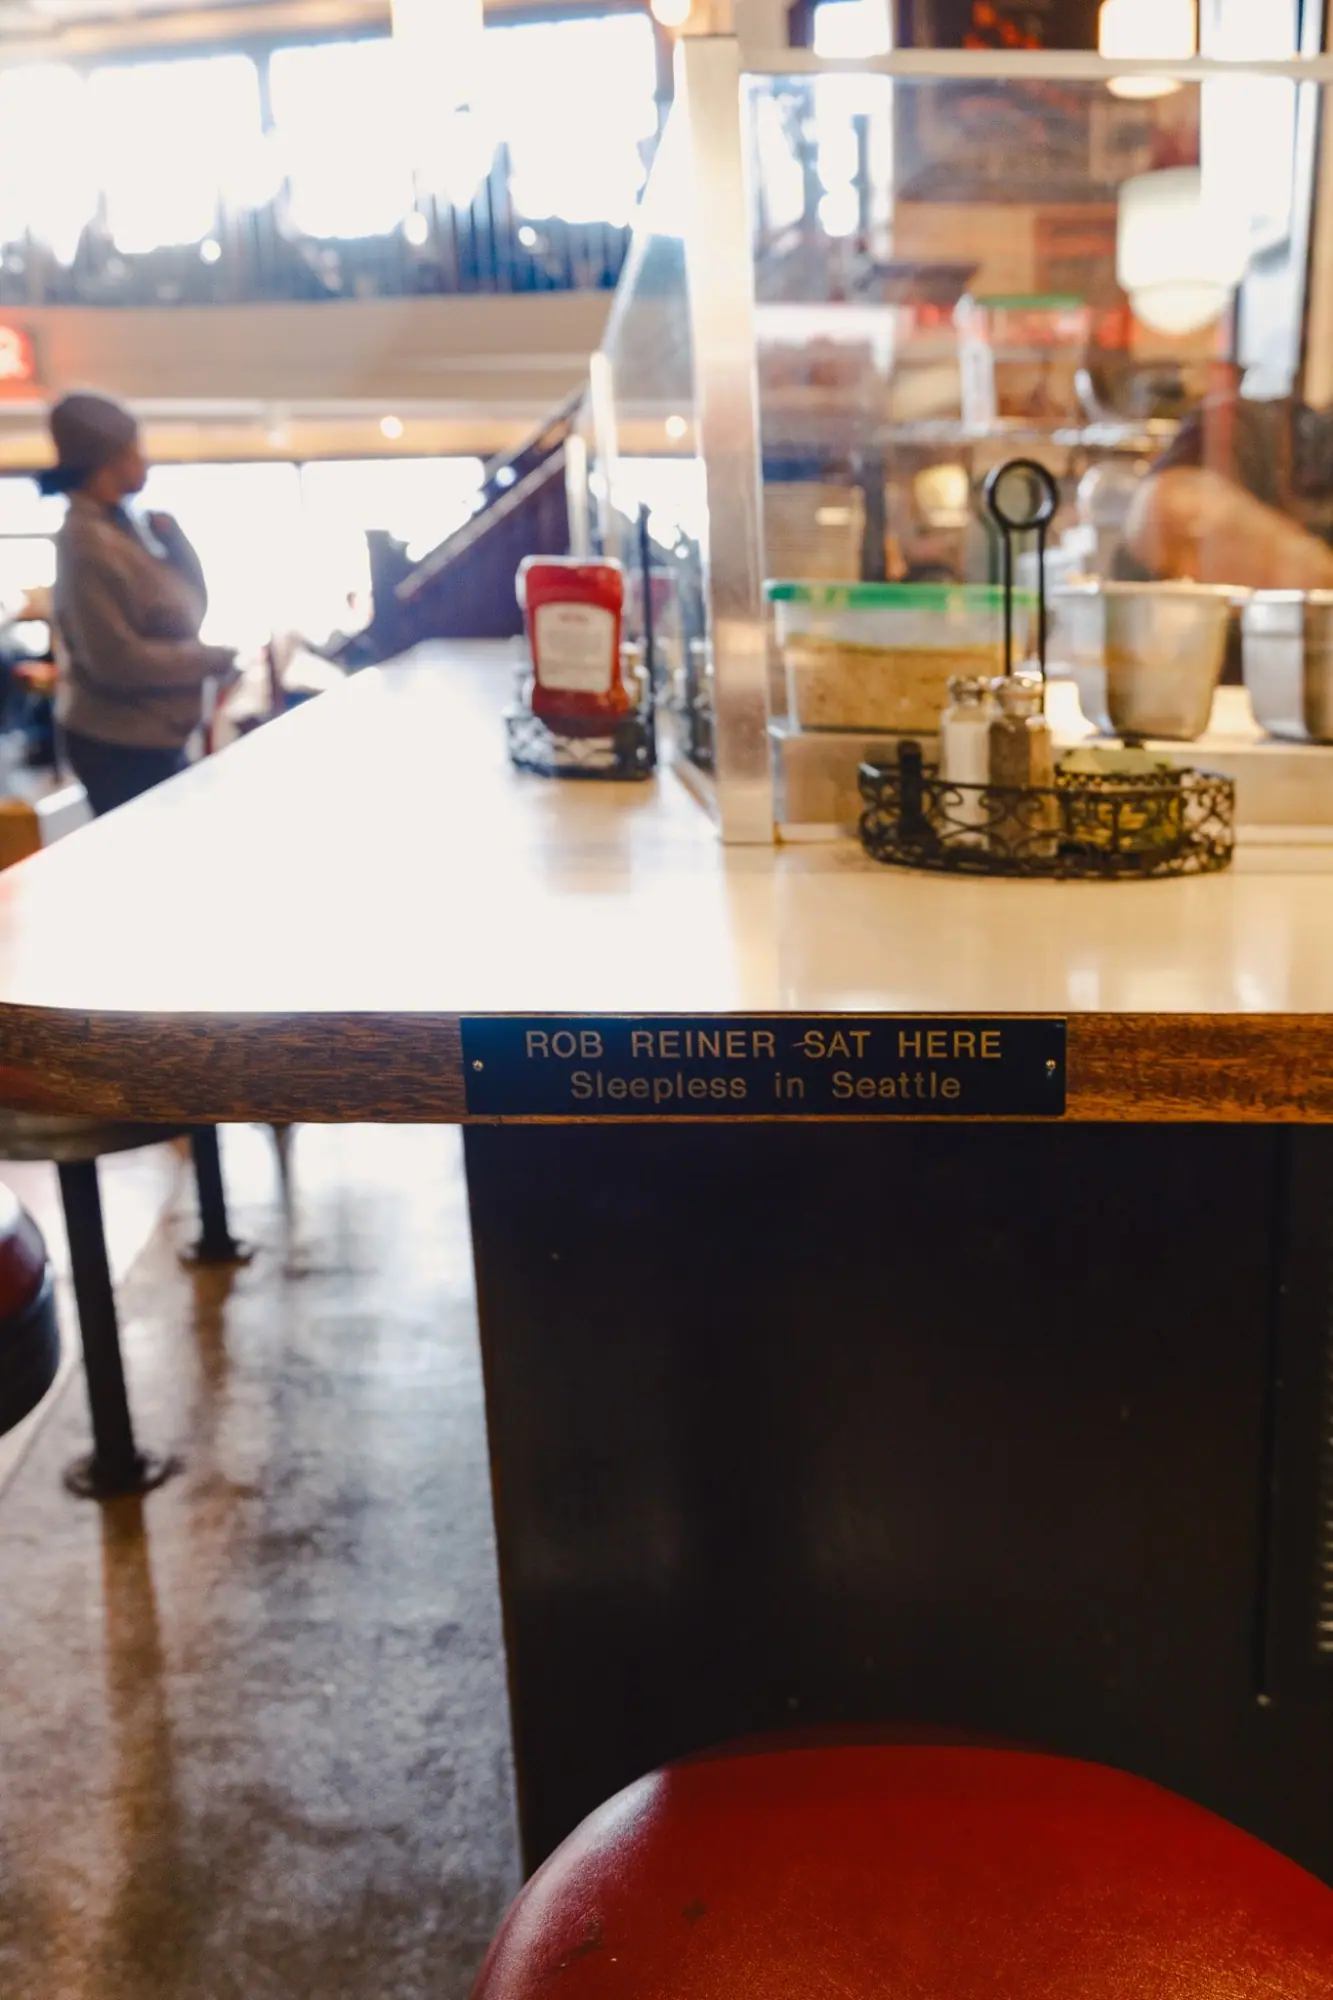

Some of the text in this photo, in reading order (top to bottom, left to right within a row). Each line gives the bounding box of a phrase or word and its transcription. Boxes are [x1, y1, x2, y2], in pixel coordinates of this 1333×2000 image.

[526, 1030, 1002, 1059] ROB REINER SAT HERE
[571, 1070, 961, 1104] Sleepless in Seattle
